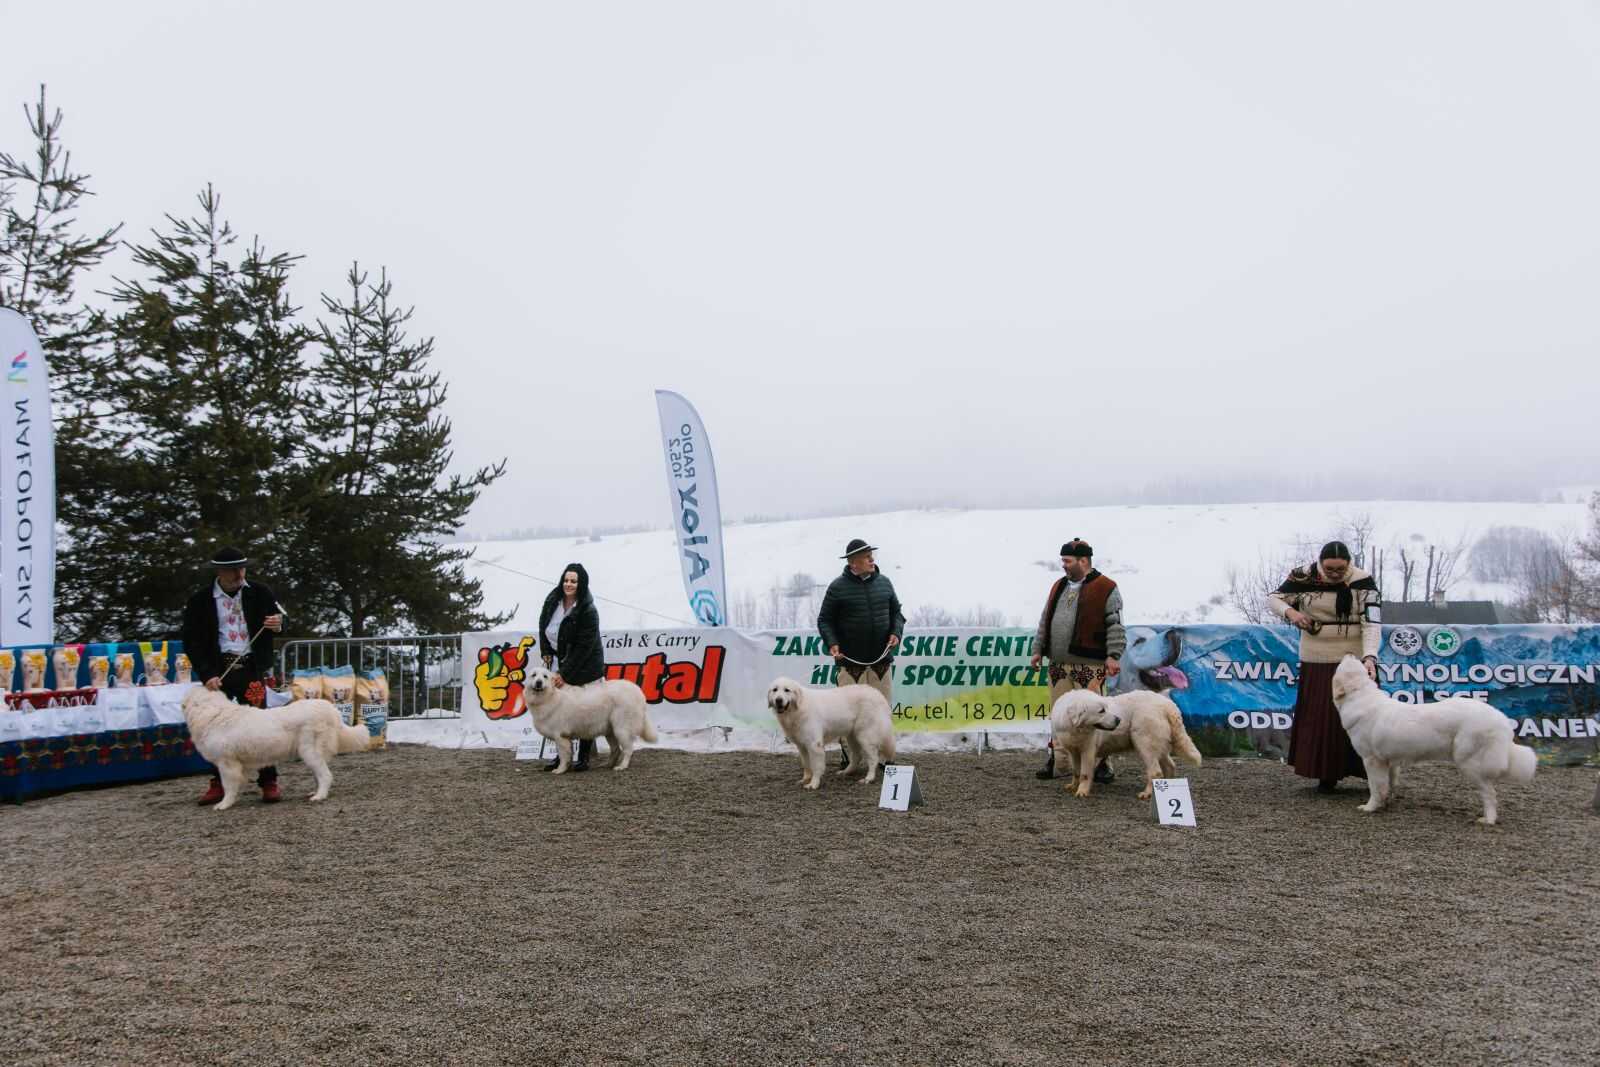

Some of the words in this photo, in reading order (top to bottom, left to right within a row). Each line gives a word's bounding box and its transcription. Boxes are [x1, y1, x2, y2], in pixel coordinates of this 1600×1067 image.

[601, 633, 632, 648] ash
[638, 633, 649, 648] &
[656, 633, 701, 652] Carry
[1378, 663, 1600, 684] YNOLOGICZN
[891, 702, 918, 721] 4c,
[925, 701, 954, 719] tel.
[962, 703, 985, 720] 18
[992, 703, 1016, 720] 20
[1024, 703, 1050, 720] 14
[1227, 710, 1294, 730] ODD
[889, 784, 899, 800] 1
[1168, 798, 1183, 817] 2
